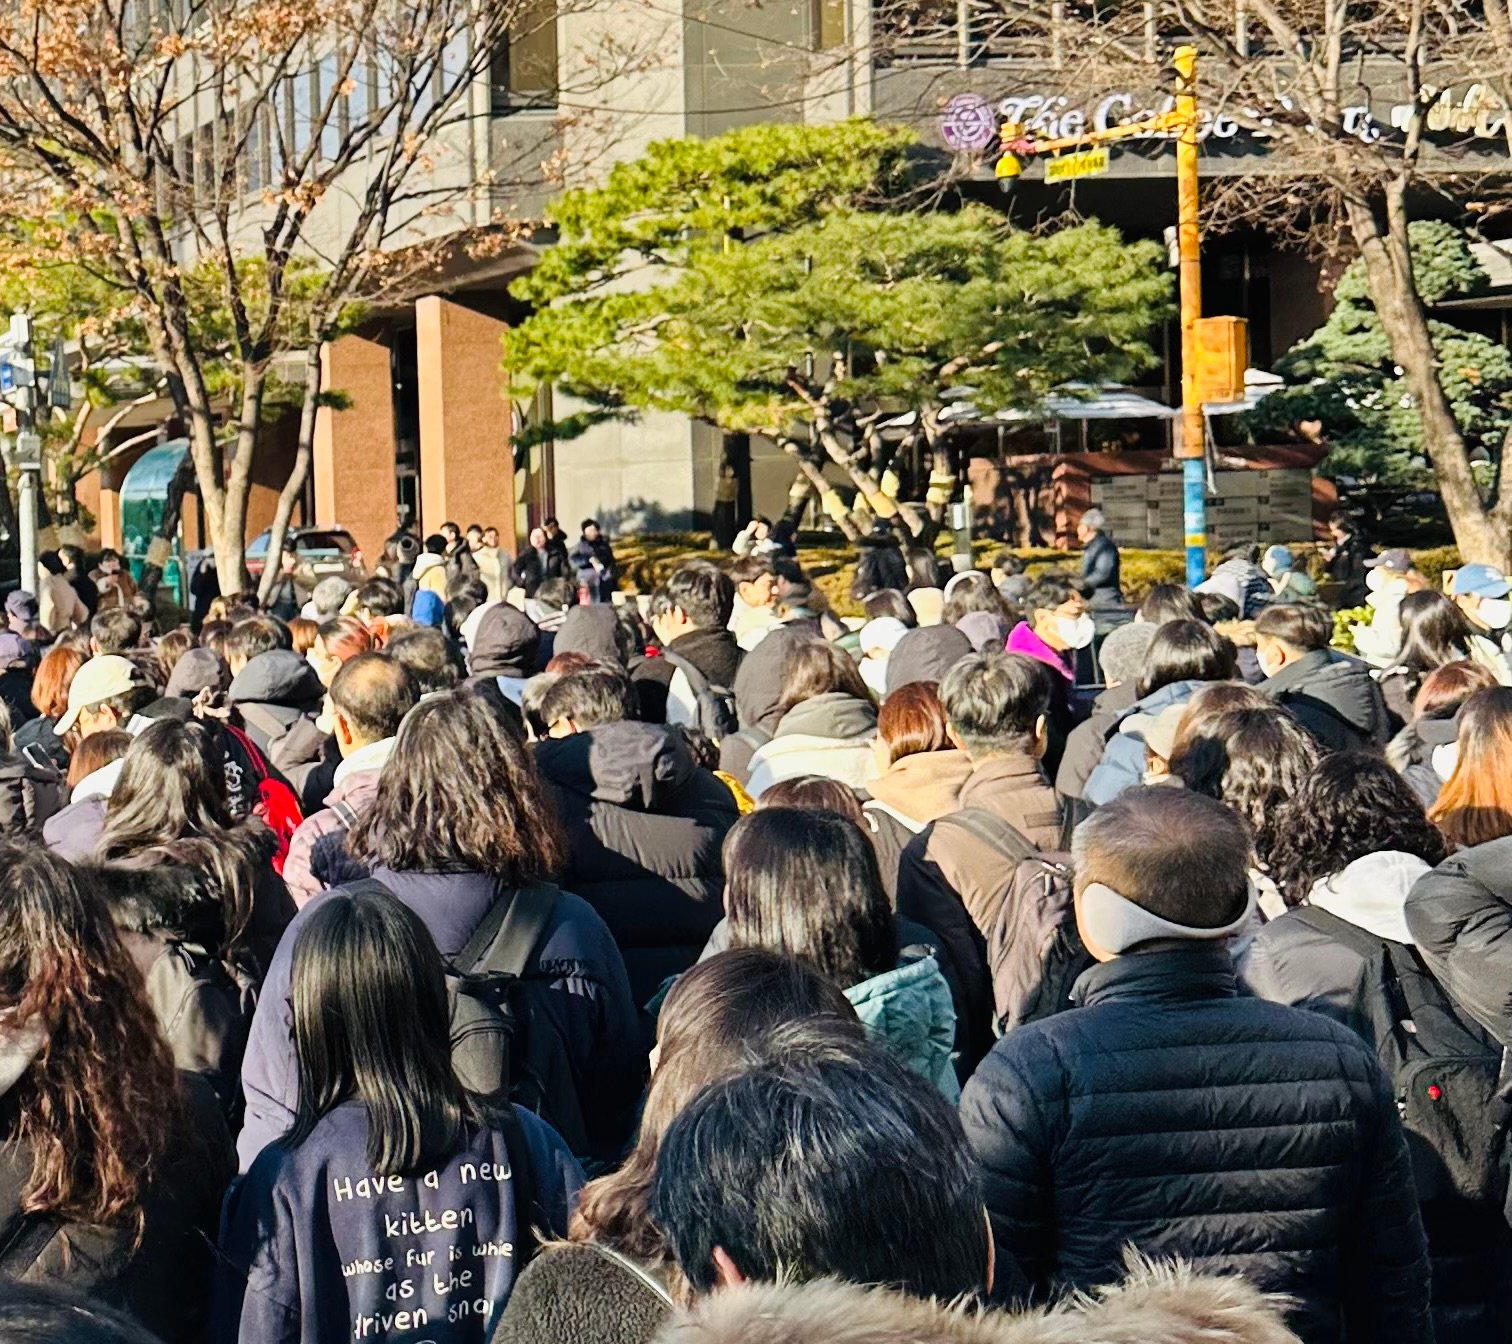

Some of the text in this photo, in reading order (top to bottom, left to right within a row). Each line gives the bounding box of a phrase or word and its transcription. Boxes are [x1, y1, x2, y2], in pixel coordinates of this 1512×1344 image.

[999, 95, 1084, 140] The
[333, 1162, 512, 1202] Have a new
[384, 1207, 473, 1238] kitten
[341, 1256, 394, 1277] whose
[406, 1248, 436, 1268] fur
[449, 1245, 463, 1262] is
[385, 1269, 473, 1302] as the
